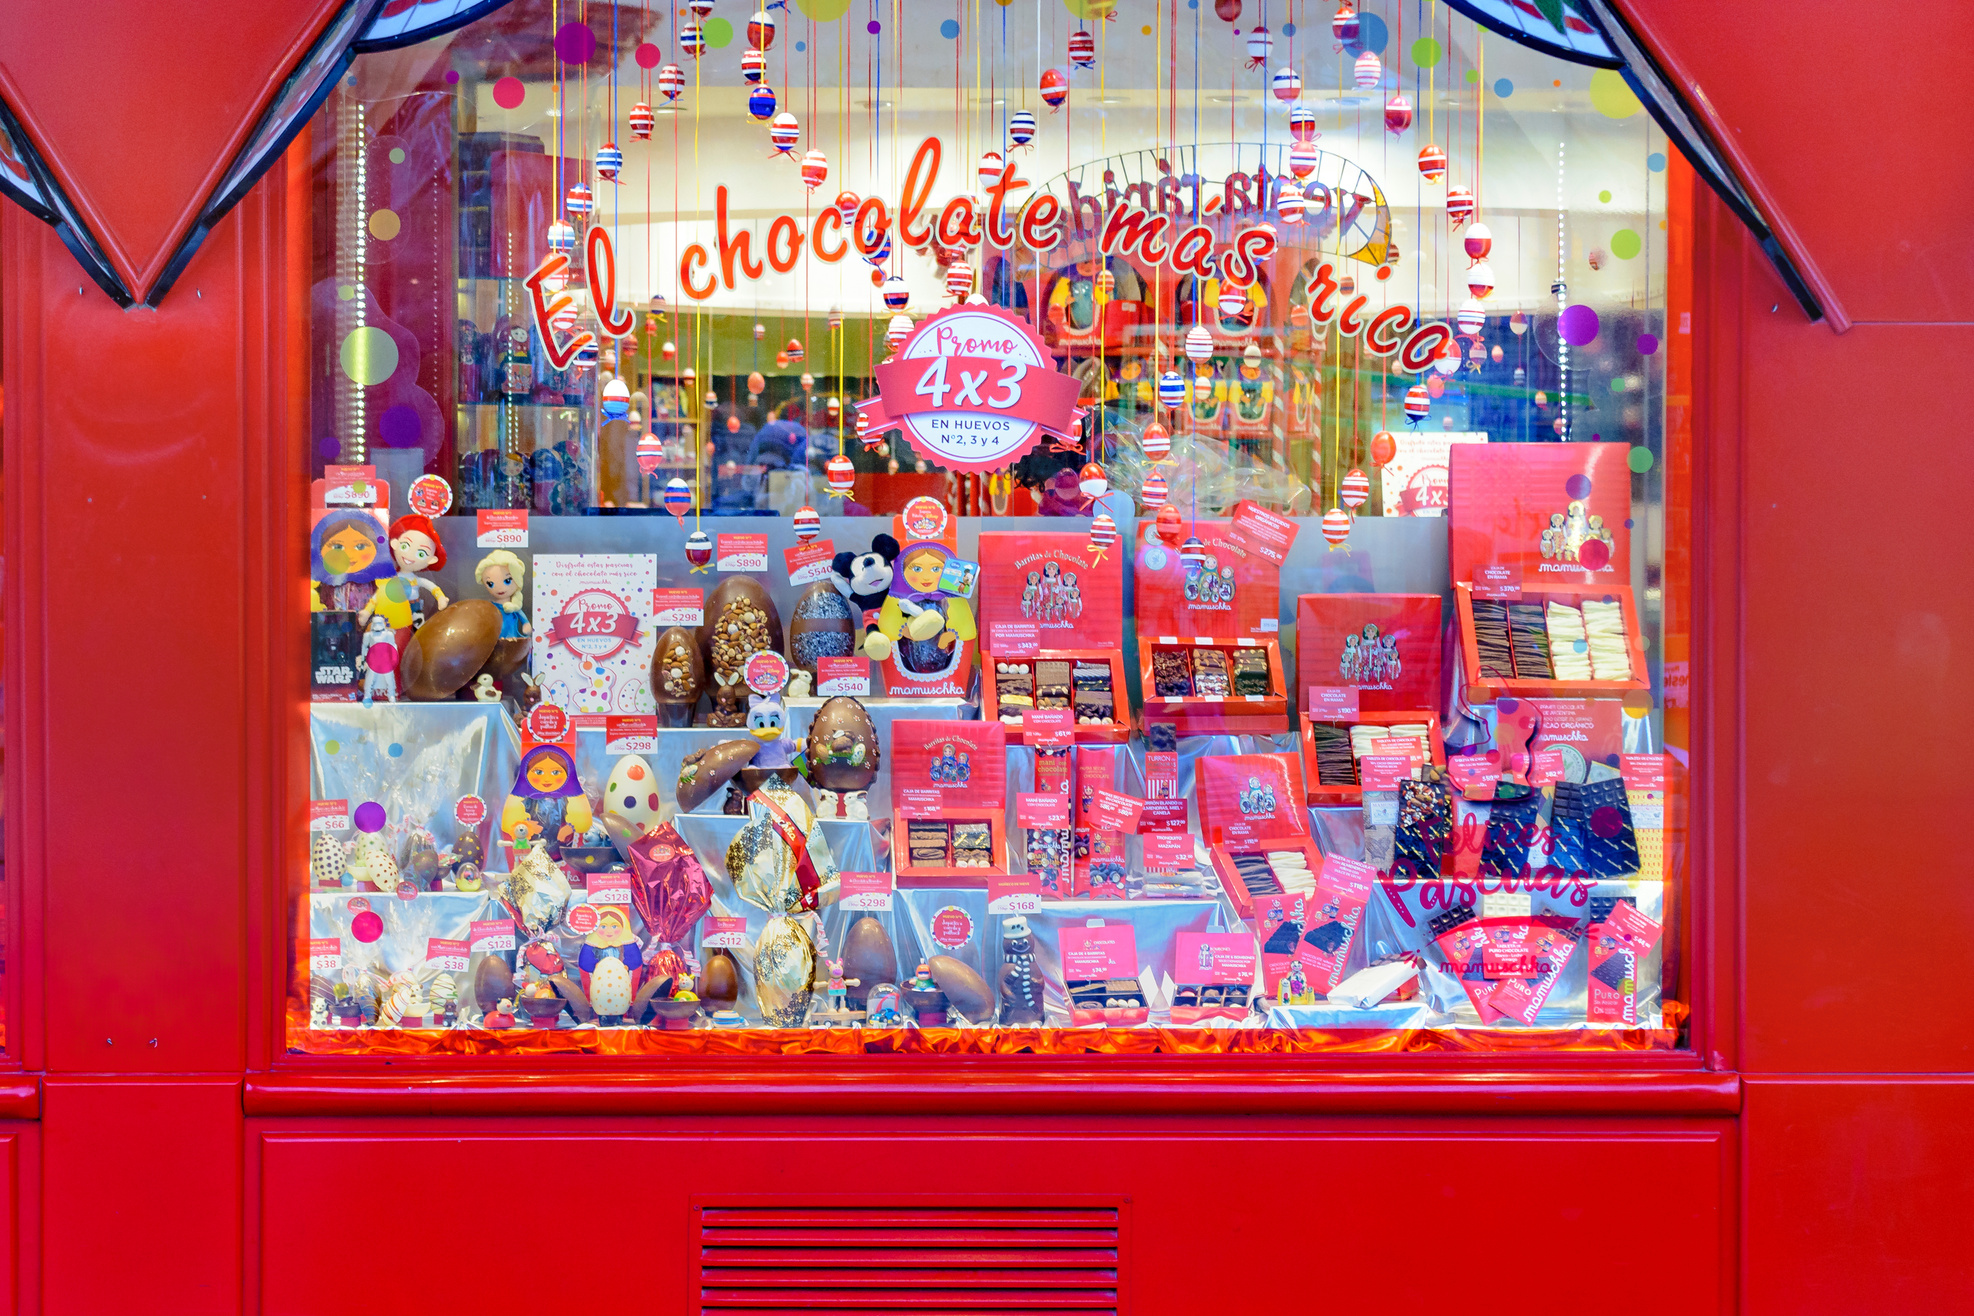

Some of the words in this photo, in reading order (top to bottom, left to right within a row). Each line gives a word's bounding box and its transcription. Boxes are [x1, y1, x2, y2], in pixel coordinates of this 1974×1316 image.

[523, 224, 637, 371] El
[679, 136, 1062, 301] chocolate
[1099, 193, 1279, 290] más
[1305, 262, 1453, 374] rico
[936, 326, 1018, 356] Promo
[915, 356, 1028, 409] 4x3
[931, 418, 953, 431] EN
[955, 419, 1010, 432] HUEVOS
[970, 433, 979, 446] 3
[981, 436, 990, 449] y
[992, 433, 1000, 446] 4
[497, 535, 522, 543] $890
[1212, 539, 1247, 559] Chocolate
[737, 559, 761, 567] $890
[1014, 552, 1043, 569] Barritas
[1053, 550, 1089, 569] Chocolate
[808, 565, 833, 578] $540
[578, 599, 614, 612] Promo
[1188, 602, 1231, 611] mamuschka
[570, 611, 619, 634] 4x3
[672, 613, 697, 622] $298
[1040, 621, 1074, 629] amuschka
[319, 666, 352, 676] STAR
[315, 672, 354, 684] WARS
[837, 683, 863, 691] $540
[889, 682, 965, 695] mamuschka
[1349, 682, 1394, 691] amuschka
[626, 741, 651, 751] $298
[325, 820, 345, 830] $66
[1416, 812, 1567, 868] Felices
[604, 893, 629, 902] $128
[1377, 858, 1598, 928] Pascuas
[859, 899, 886, 907] $298
[1009, 902, 1035, 910] $168
[487, 940, 512, 949] $128
[719, 937, 741, 946] $112
[1328, 906, 1362, 988] mamuschka
[316, 960, 336, 969] $38
[444, 961, 464, 970] $38
[1438, 955, 1553, 973] mamuschka
[1507, 977, 1532, 996] PURO
[1523, 943, 1574, 1023] mamuschka
[1619, 946, 1637, 1023] mamusch
[1594, 989, 1620, 1000] PURO
